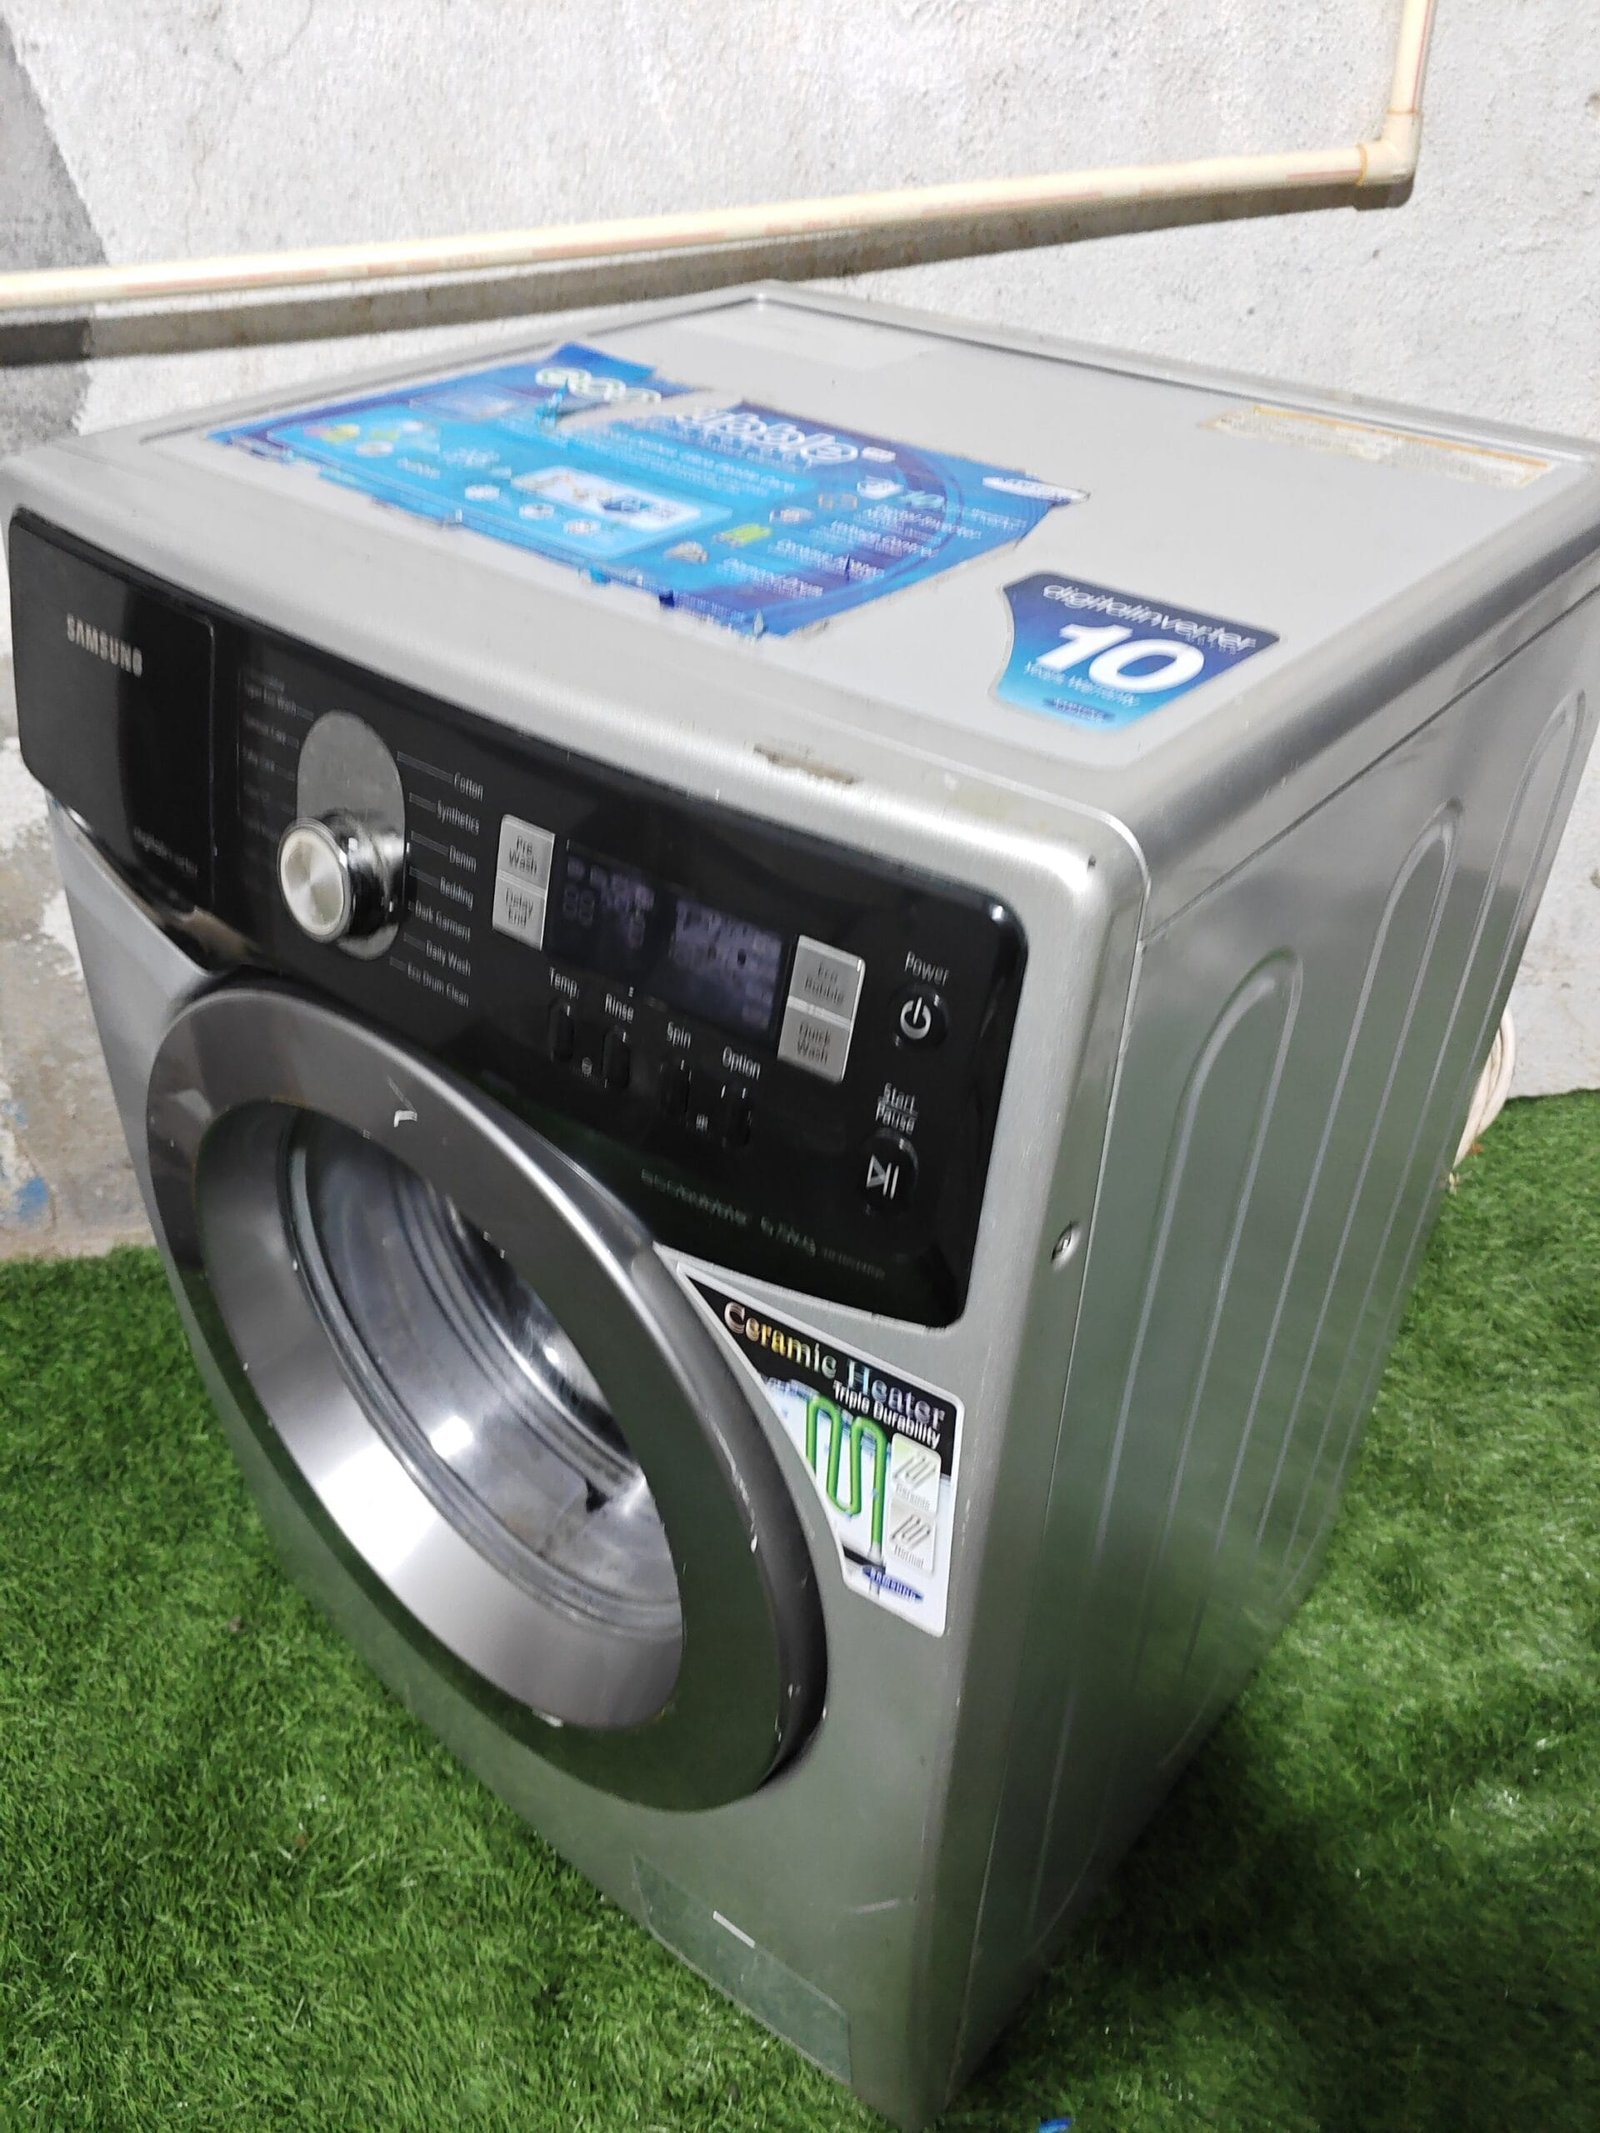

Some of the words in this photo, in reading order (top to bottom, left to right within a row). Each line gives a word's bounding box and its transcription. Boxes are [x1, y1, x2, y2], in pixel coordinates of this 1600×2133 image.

[67, 612, 143, 678] SAMSUNG
[1035, 622, 1204, 695] 10
[454, 771, 483, 802] Cotton
[437, 799, 480, 836] Synthetics
[449, 844, 477, 873] Denim
[515, 835, 533, 855] Pre
[509, 848, 538, 877] Wash
[440, 876, 473, 912] Bedding
[505, 888, 533, 919] Delay
[415, 899, 434, 923] Dark
[508, 906, 528, 928] End
[426, 939, 446, 967] Daily
[448, 951, 471, 977] Wash
[904, 950, 950, 987] Power
[605, 992, 635, 1024] Rinse
[667, 1020, 692, 1050] Spin
[722, 1045, 761, 1081] Option
[883, 1082, 917, 1114] Start
[724, 1301, 837, 1379] Ceramic
[847, 1358, 946, 1430] Heater
[833, 1379, 869, 1415] Triple
[872, 1401, 942, 1450] Durability
